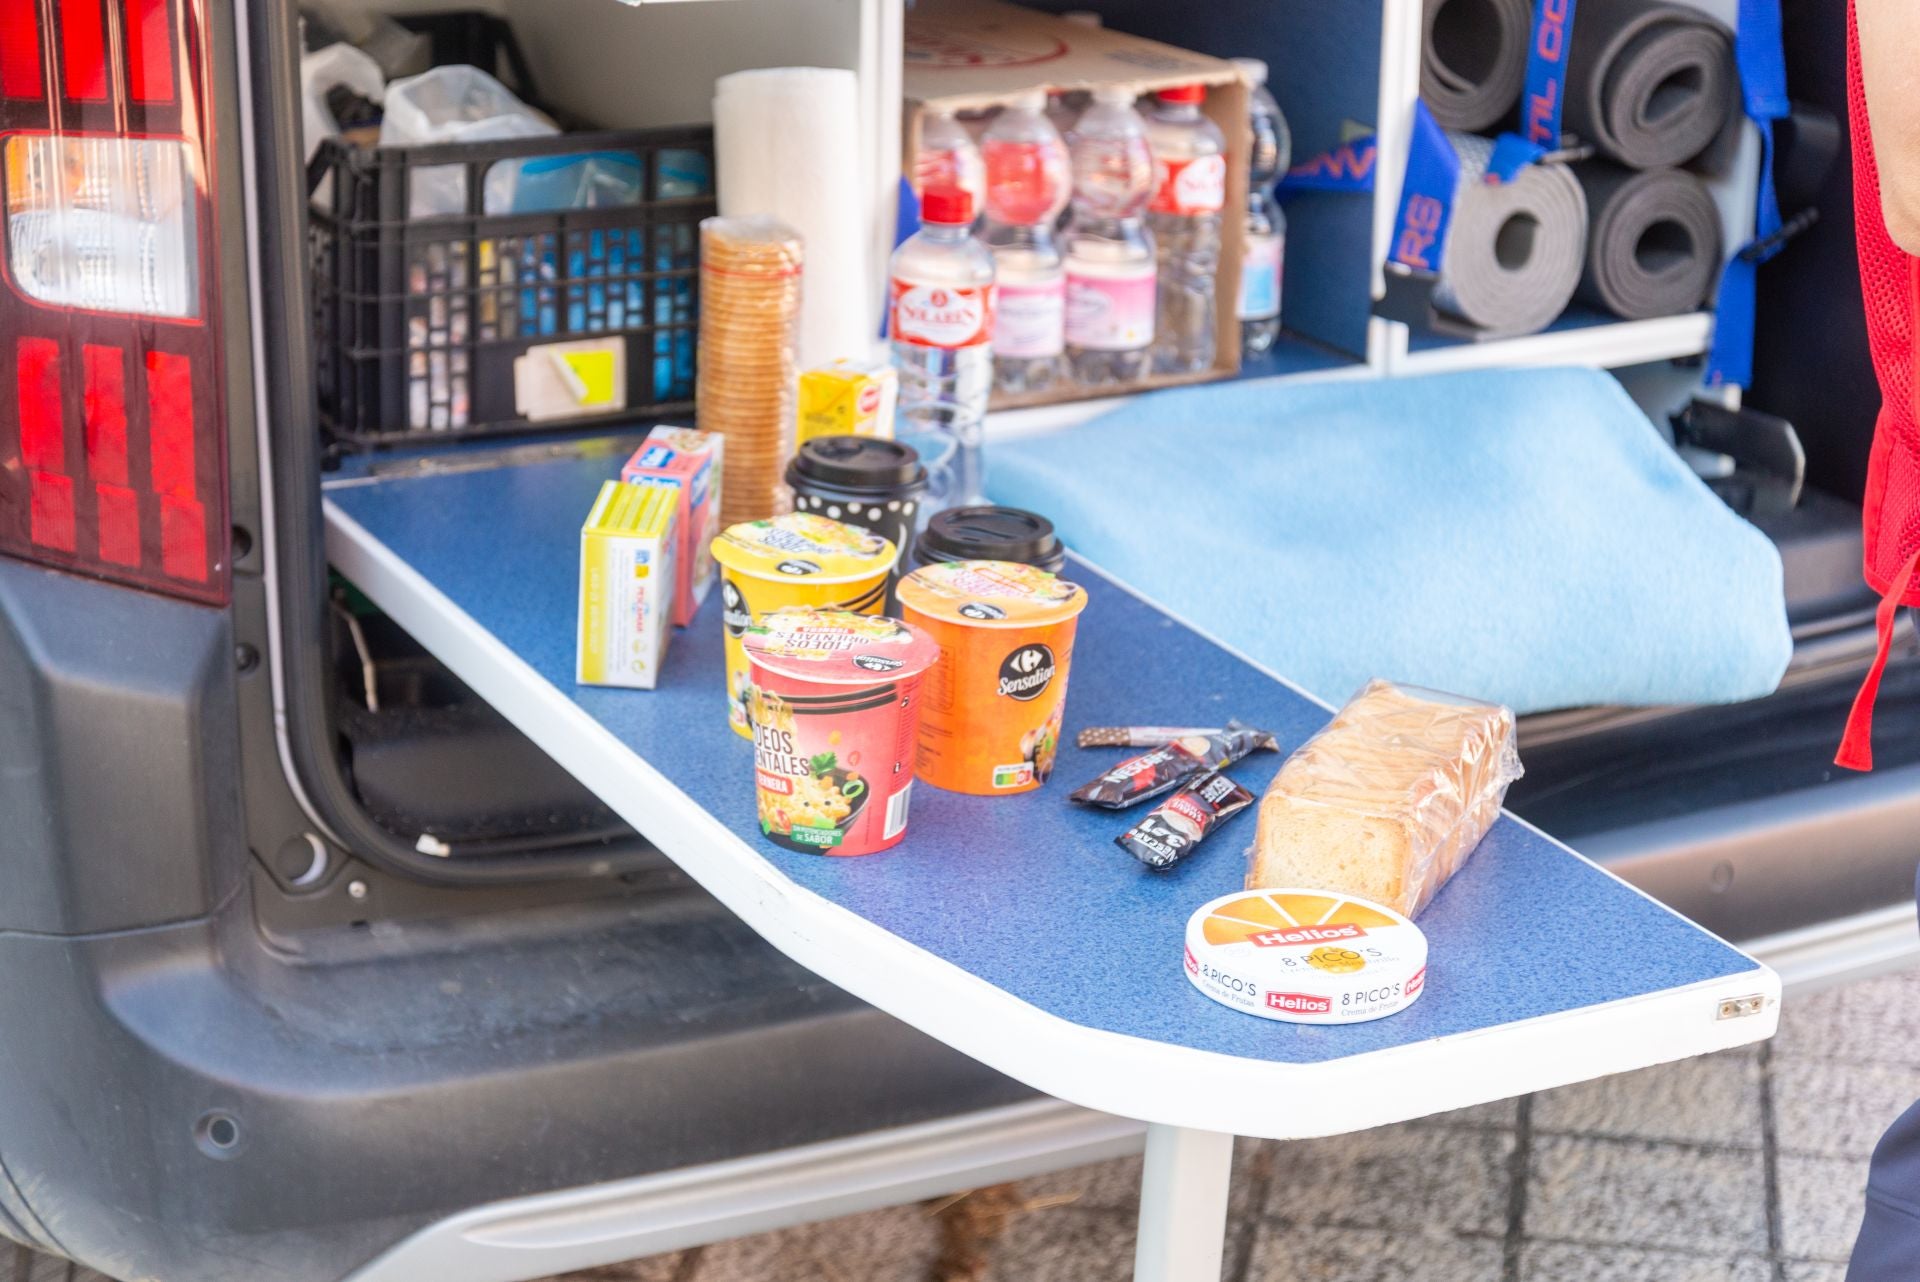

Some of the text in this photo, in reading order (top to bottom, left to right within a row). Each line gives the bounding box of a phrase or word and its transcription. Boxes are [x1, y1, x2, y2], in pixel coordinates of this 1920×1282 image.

[785, 639, 854, 650] FIDEOS
[996, 664, 1057, 697] Sensation
[804, 834, 833, 845] SABOR
[1256, 926, 1357, 946] Helios
[1281, 956, 1297, 967] 8
[1270, 994, 1329, 1012] Helios
[1341, 982, 1400, 1006] 8 PICO'S
